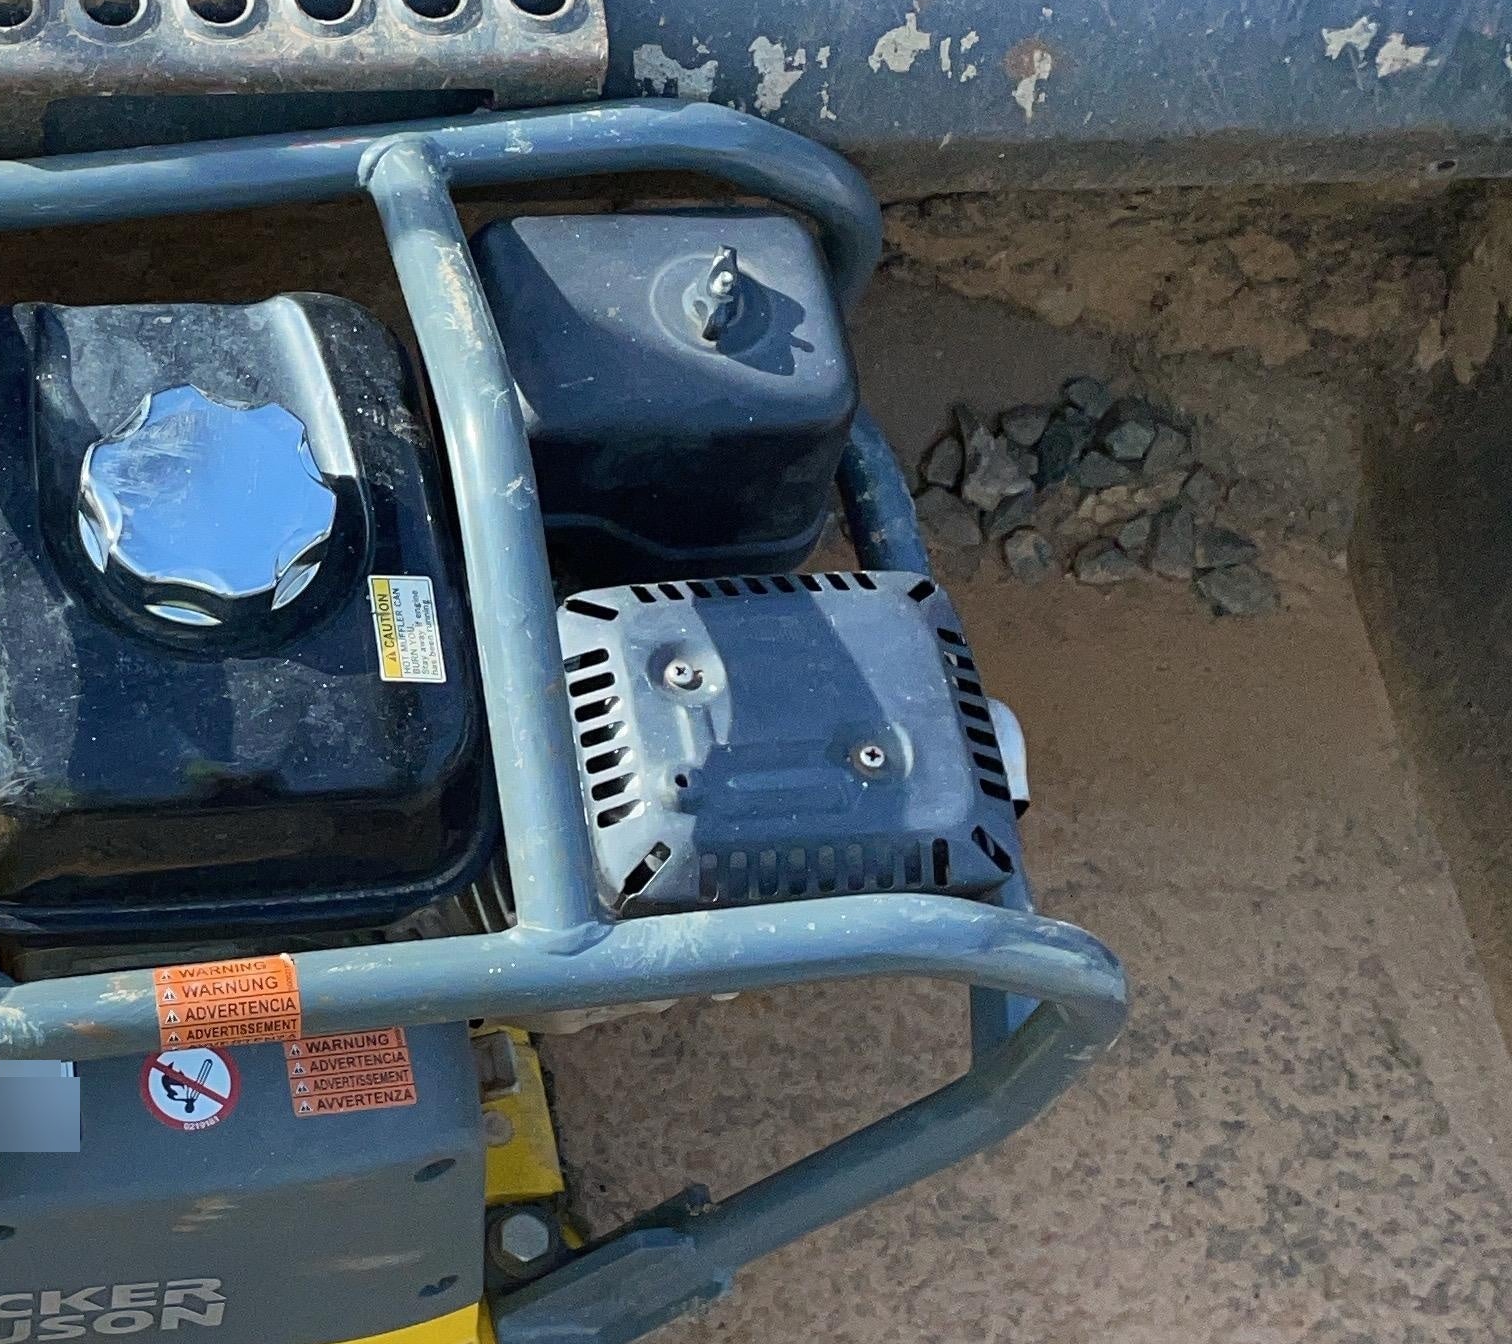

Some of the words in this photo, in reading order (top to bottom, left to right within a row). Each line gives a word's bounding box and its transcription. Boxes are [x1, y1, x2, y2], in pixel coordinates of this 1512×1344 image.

[392, 588, 402, 607] CAN
[412, 590, 421, 619] engine
[378, 594, 395, 648] CAUTION
[396, 610, 408, 653] MUFFLER
[418, 630, 427, 653] away
[428, 635, 437, 657] been
[403, 655, 411, 674] HOT
[410, 648, 420, 675] BURN
[420, 655, 430, 675] Stay
[431, 660, 439, 676] has
[178, 961, 267, 978] WARNING
[181, 976, 278, 998] WARNUNG
[185, 997, 297, 1022] ADVERTENCIA
[186, 1018, 297, 1041] ADVERTISSEMENT
[305, 1033, 389, 1054] WARNUNG
[310, 1051, 406, 1073] ADVERTENCIA
[313, 1069, 409, 1092] ADVERTISSEMENT
[316, 1088, 414, 1111] AVVERTENZA
